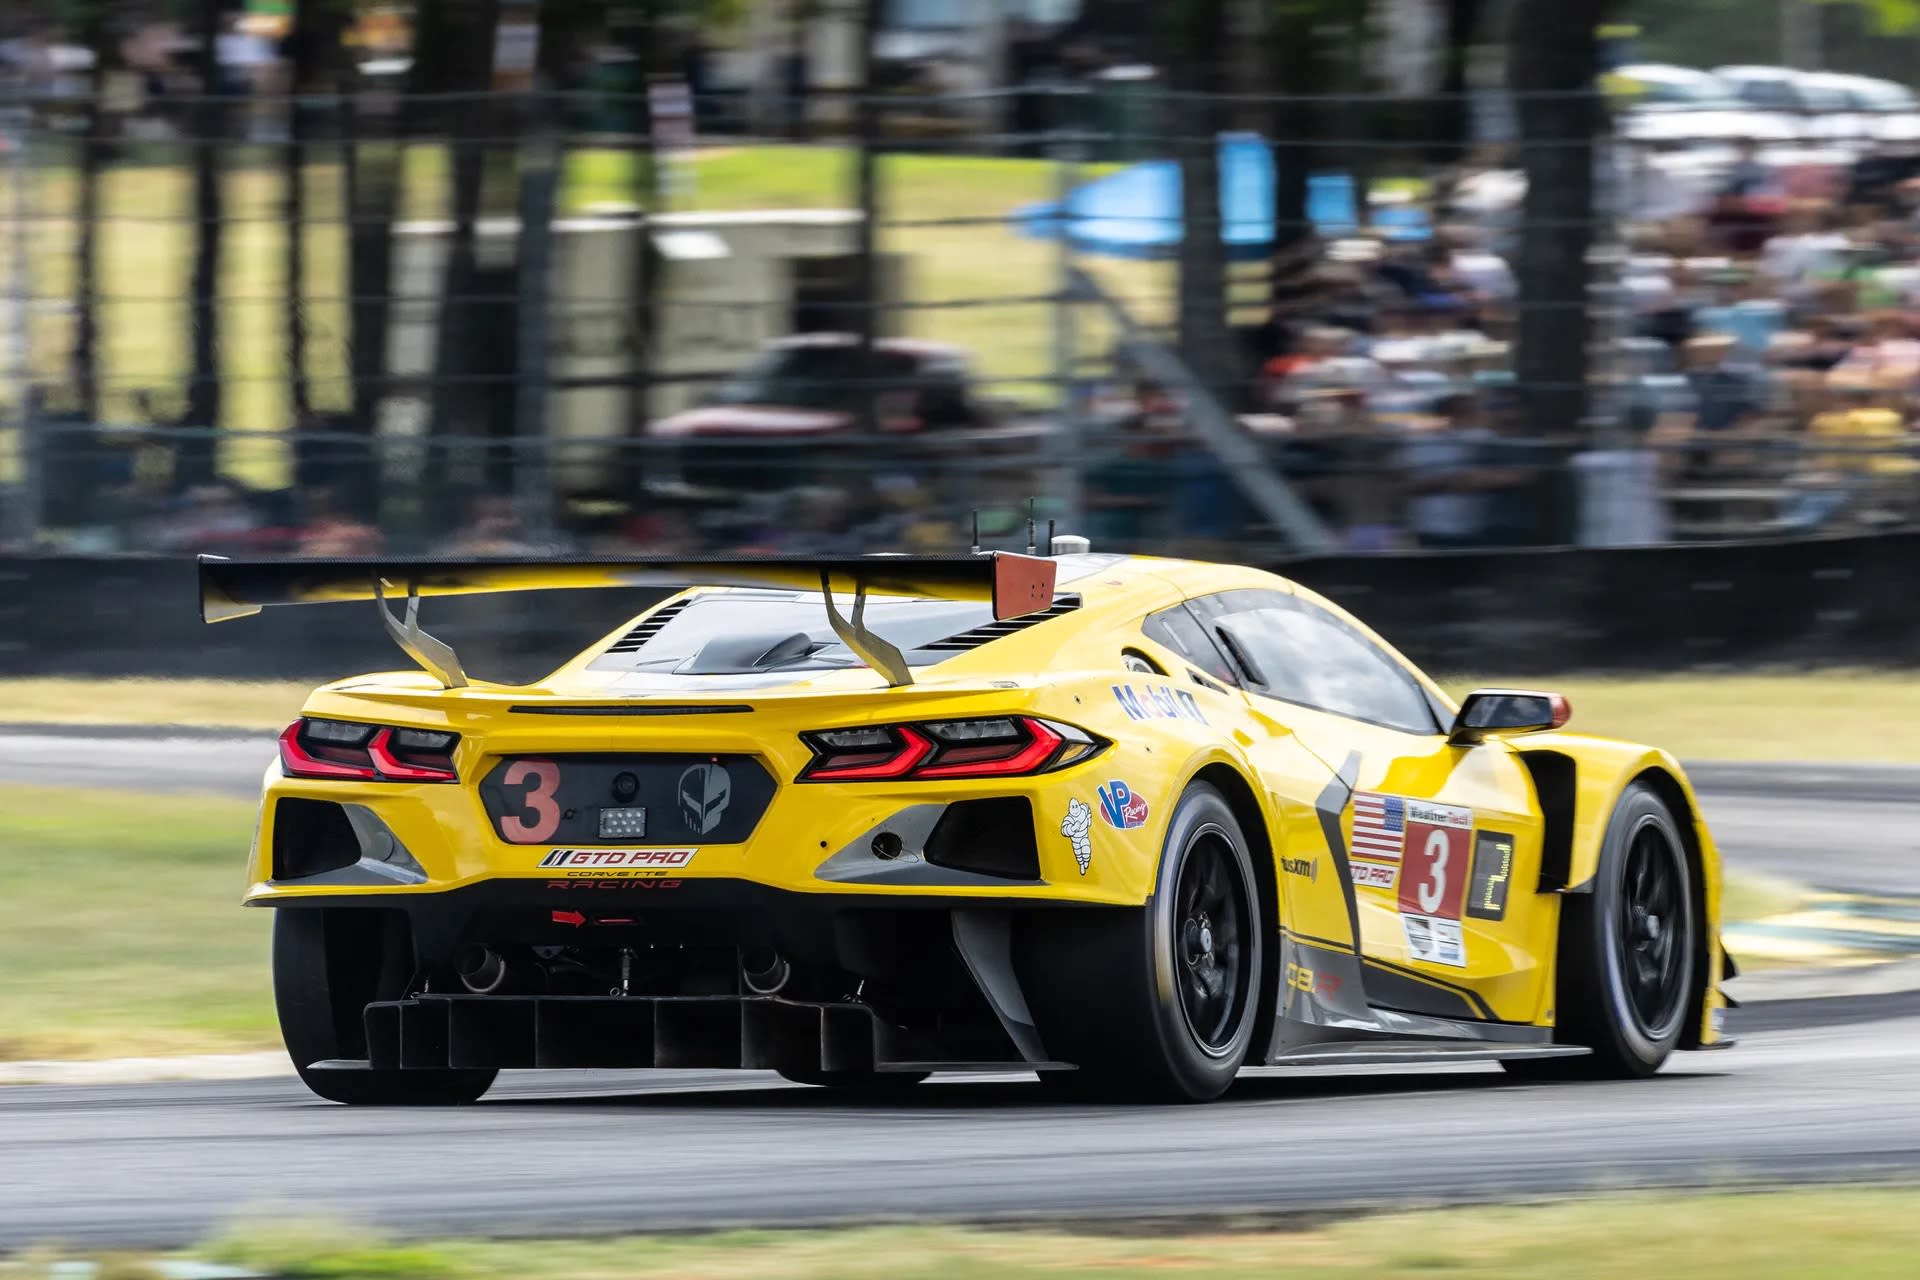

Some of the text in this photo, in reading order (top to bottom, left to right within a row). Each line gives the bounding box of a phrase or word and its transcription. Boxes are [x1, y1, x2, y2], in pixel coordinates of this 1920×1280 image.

[1112, 684, 1185, 720] Mobil
[500, 760, 560, 844] 3
[1097, 780, 1131, 829] VP
[1124, 803, 1147, 823] Racing
[569, 852, 690, 864] GTD PRO
[1418, 828, 1450, 913] 3
[546, 880, 683, 889] RACING
